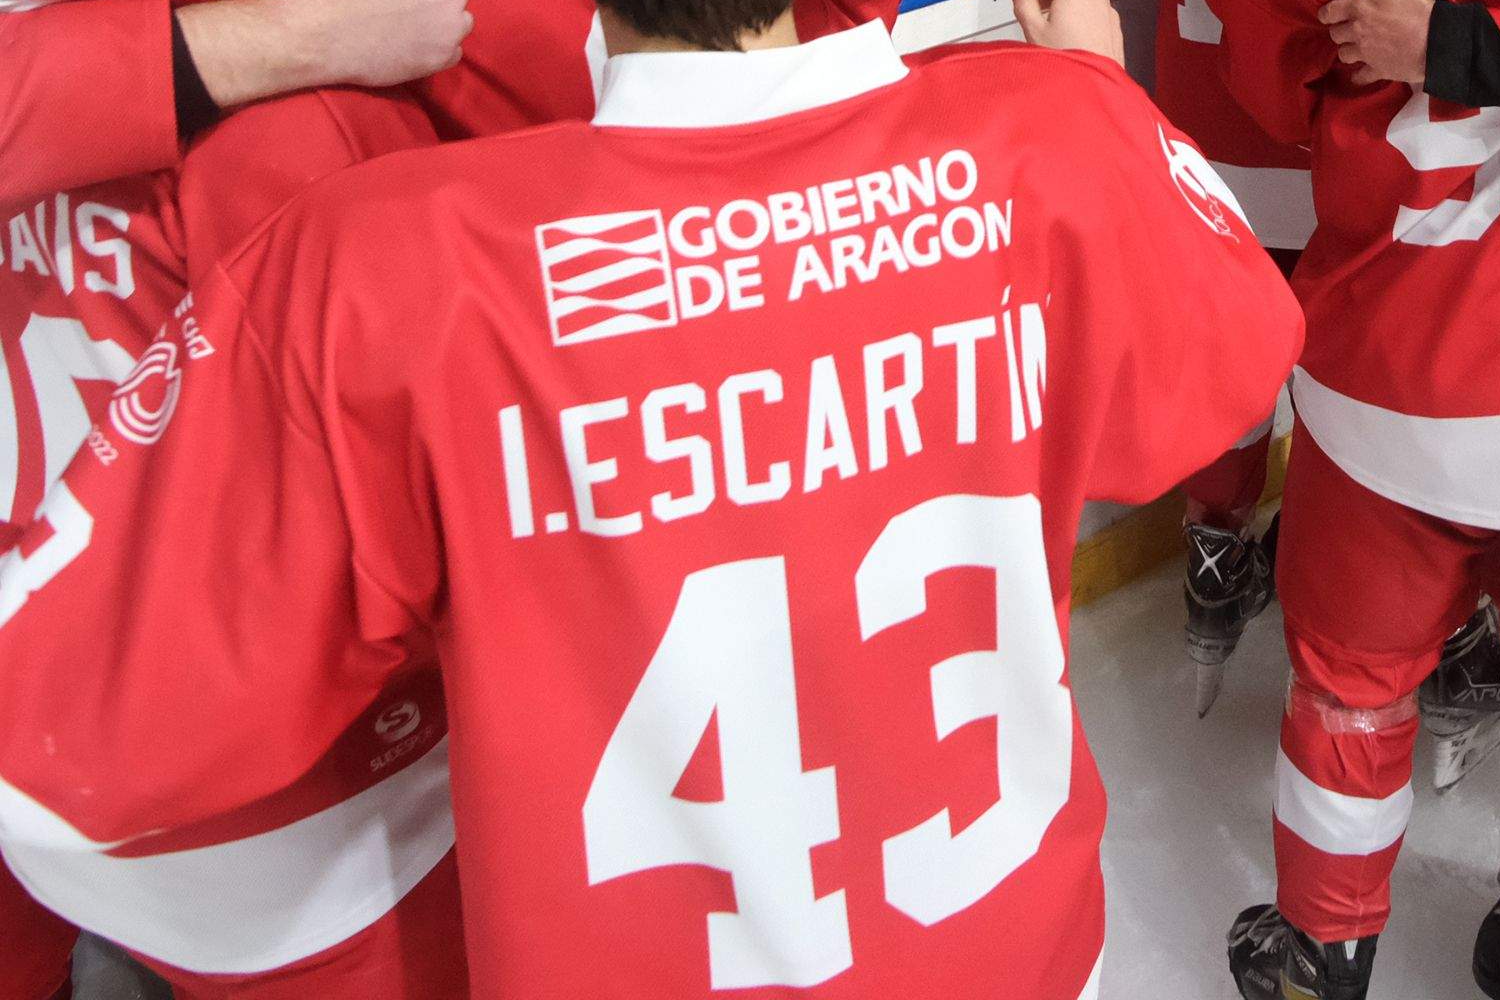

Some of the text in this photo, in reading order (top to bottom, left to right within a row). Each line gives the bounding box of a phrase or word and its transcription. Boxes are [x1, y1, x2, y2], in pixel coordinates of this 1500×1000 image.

[668, 149, 978, 258] GOBIERNO
[676, 199, 1013, 320] DE ARAGON
[498, 284, 1053, 539] I.ESCARTÍN
[582, 493, 1074, 992] 43
